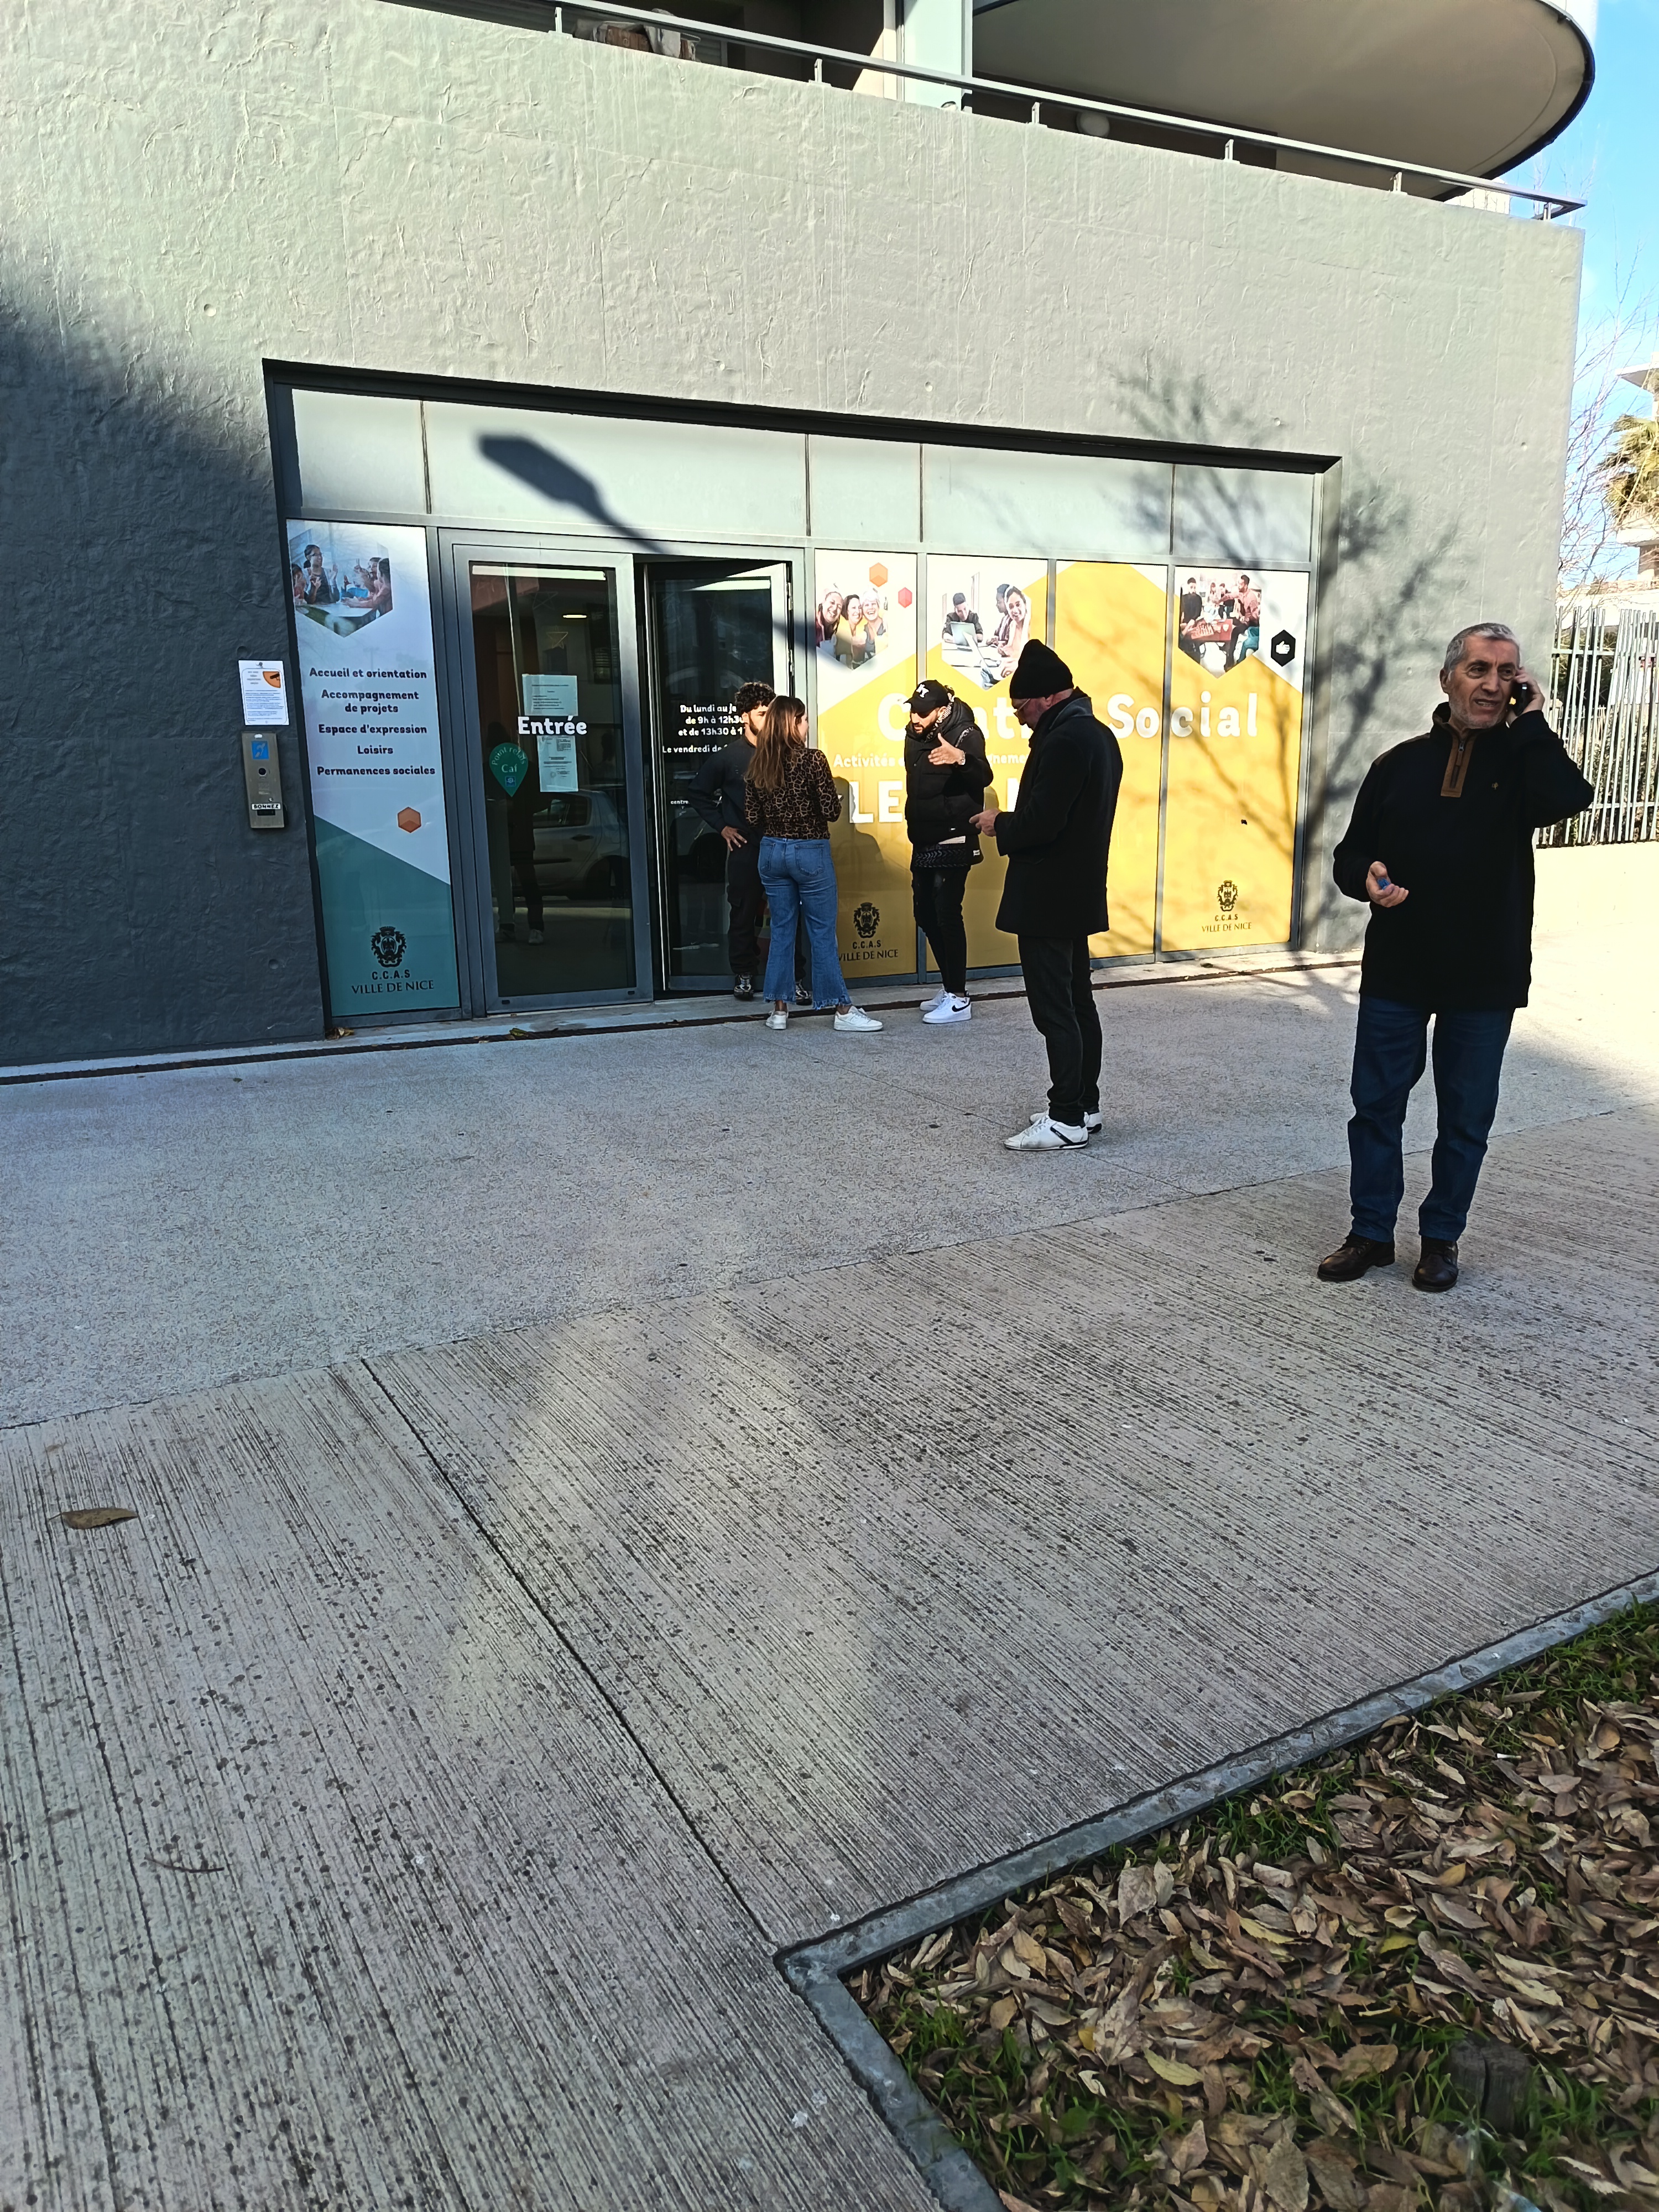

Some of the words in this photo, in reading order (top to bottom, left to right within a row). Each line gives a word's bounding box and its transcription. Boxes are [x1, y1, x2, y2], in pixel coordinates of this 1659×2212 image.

[309, 667, 349, 677] Accueil
[352, 669, 364, 677] et
[366, 668, 427, 679] orientation
[321, 690, 419, 702] Accompagnement
[345, 703, 358, 712] de
[361, 703, 398, 714] projets
[680, 705, 692, 713] Du
[693, 704, 715, 712] lundi
[685, 716, 696, 724] de
[697, 716, 709, 724] 9h
[711, 715, 716, 724] à
[1107, 691, 1258, 739] Social
[319, 724, 357, 736] Espace
[360, 724, 427, 736] d'expression
[518, 715, 587, 735] Entrée
[688, 728, 699, 736] de
[701, 727, 729, 735] 13h30
[731, 726, 737, 735] à
[357, 744, 394, 754] Loisirs
[674, 744, 710, 753] vendredi
[492, 747, 508, 765] Point
[509, 747, 526, 764] relais
[833, 753, 895, 768] Activités
[317, 766, 390, 775] Permanences
[393, 765, 435, 775] sociales
[501, 764, 518, 773] Caf
[1201, 924, 1221, 933] VILLE
[1223, 923, 1232, 931] DE
[1234, 922, 1252, 931] NICE
[863, 951, 875, 960] DE
[877, 949, 898, 959] NICE
[351, 983, 383, 994] VILLE
[387, 982, 403, 993] DE
[405, 980, 434, 991] NICE
